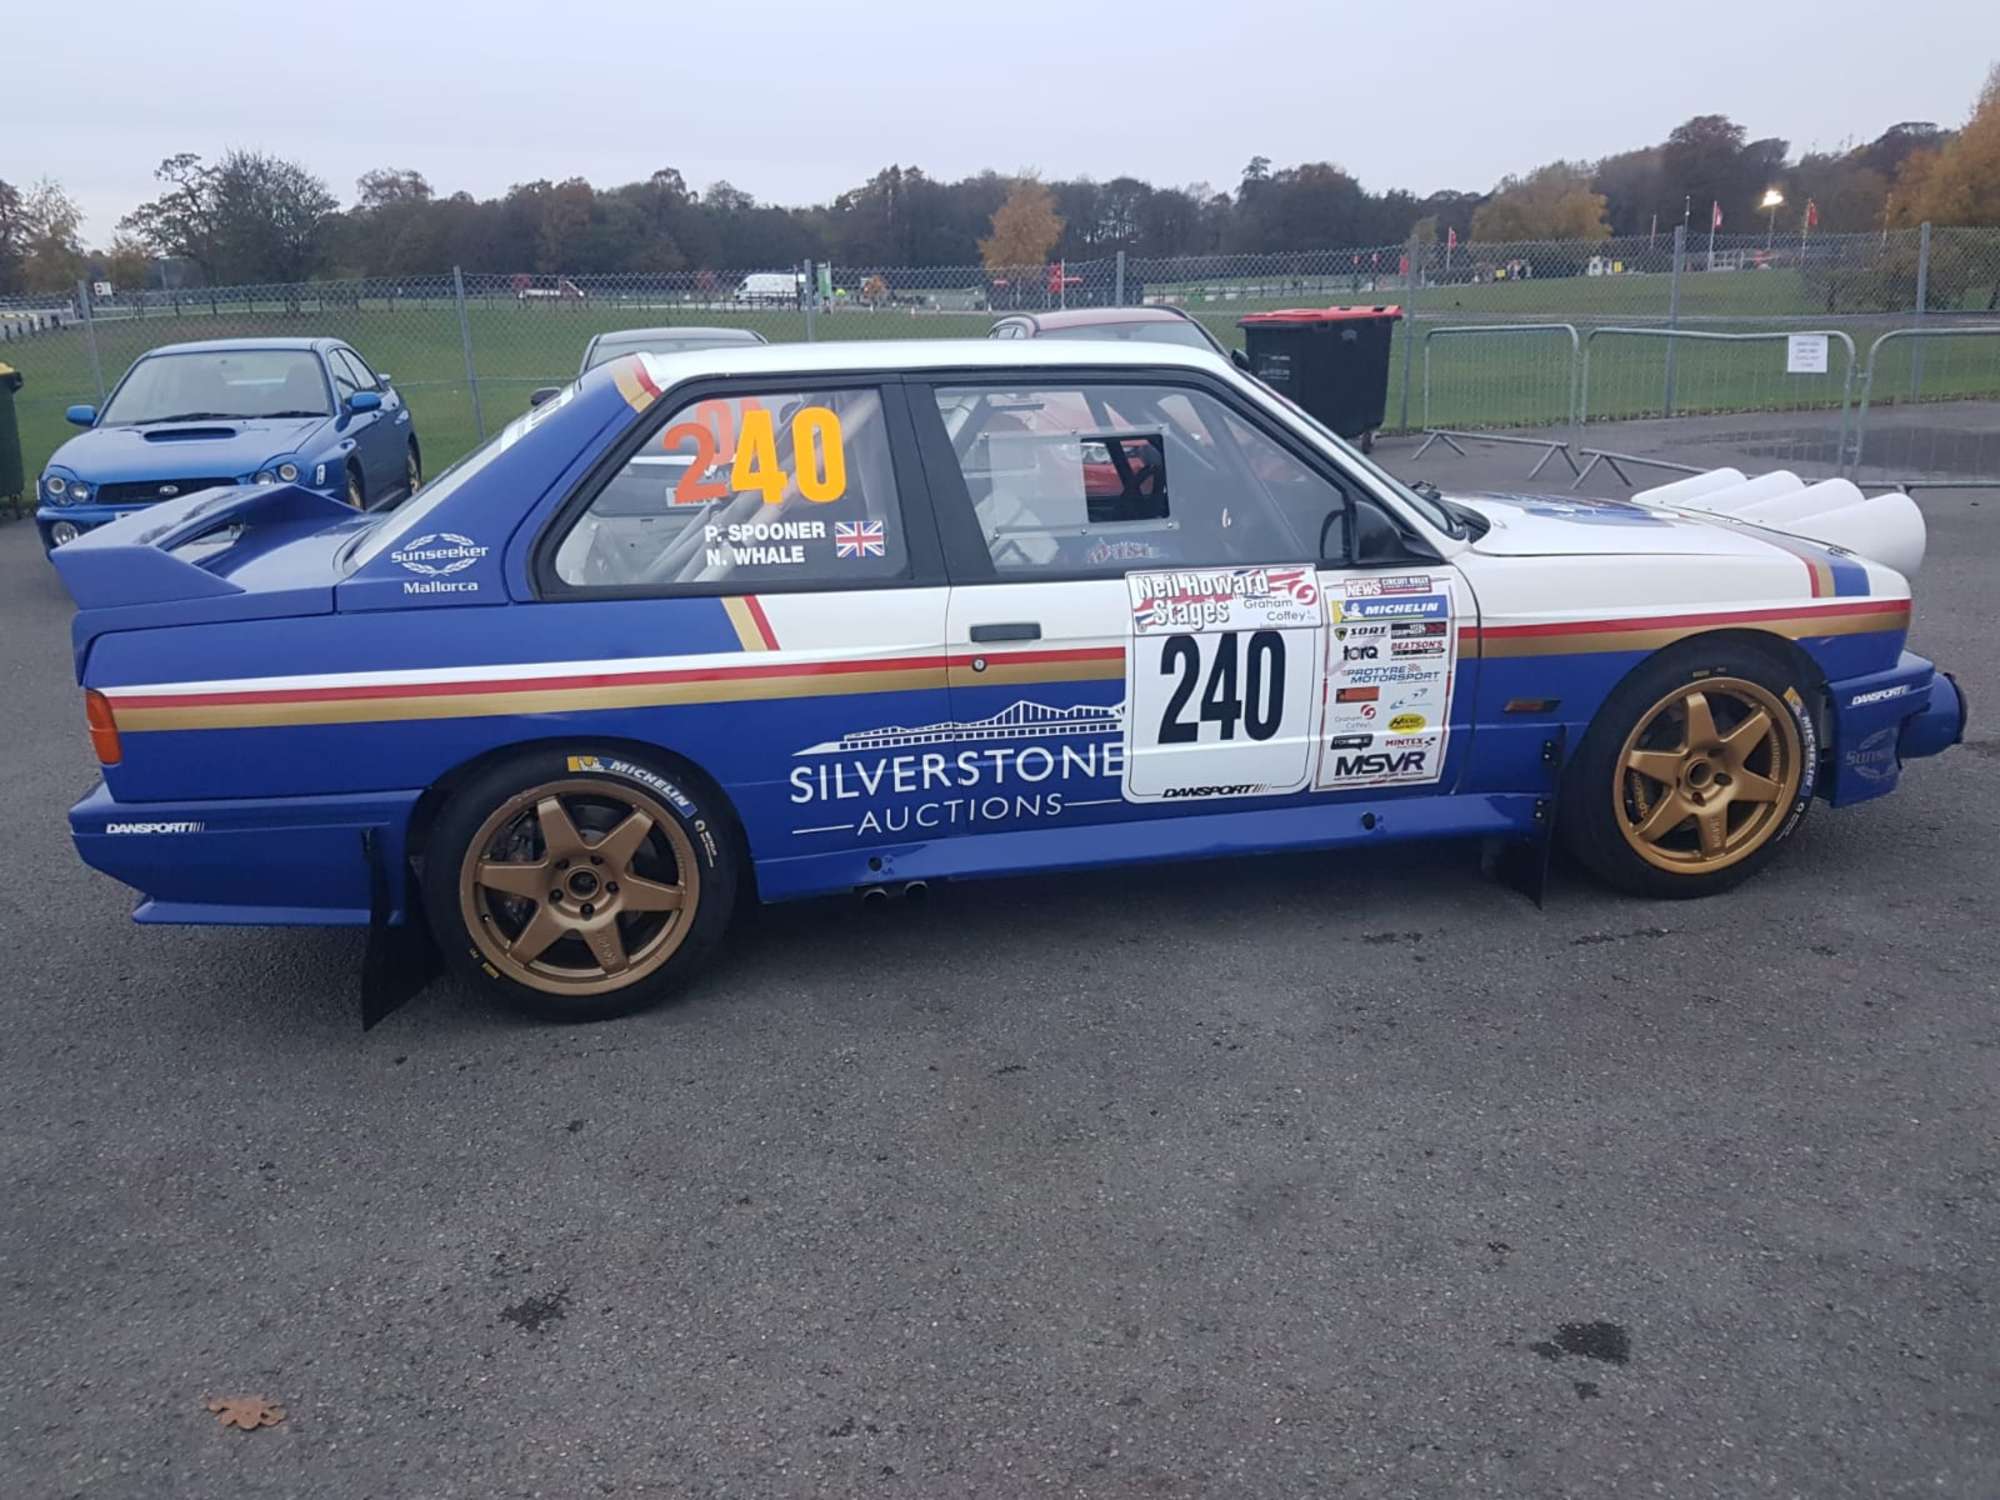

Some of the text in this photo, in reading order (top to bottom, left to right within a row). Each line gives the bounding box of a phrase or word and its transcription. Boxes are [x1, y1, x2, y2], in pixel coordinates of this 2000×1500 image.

[663, 406, 847, 504] 240
[705, 521, 826, 542] P. SPOONER
[391, 546, 489, 563] Sunseeker
[706, 546, 805, 566] N. WHALE
[403, 581, 479, 594] Mallorca
[1135, 569, 1271, 599] Neil Howard
[1243, 599, 1293, 609] Graham
[1364, 603, 1438, 615] MICHELIN
[1153, 599, 1230, 631] Stages
[1266, 610, 1306, 621] Coffey
[1158, 630, 1286, 744] 240
[1350, 672, 1440, 684] MOTORSPORT
[1385, 737, 1424, 747] MINTEX
[1802, 715, 1816, 789] MICHELIN
[790, 741, 1124, 803] SILVERSTONE
[1335, 751, 1426, 776] MSVR
[610, 760, 690, 807] MICHELIN
[1162, 784, 1254, 798] DANSPORT
[857, 793, 1062, 836] AUCTIONS
[106, 822, 189, 834] DANSPORT
